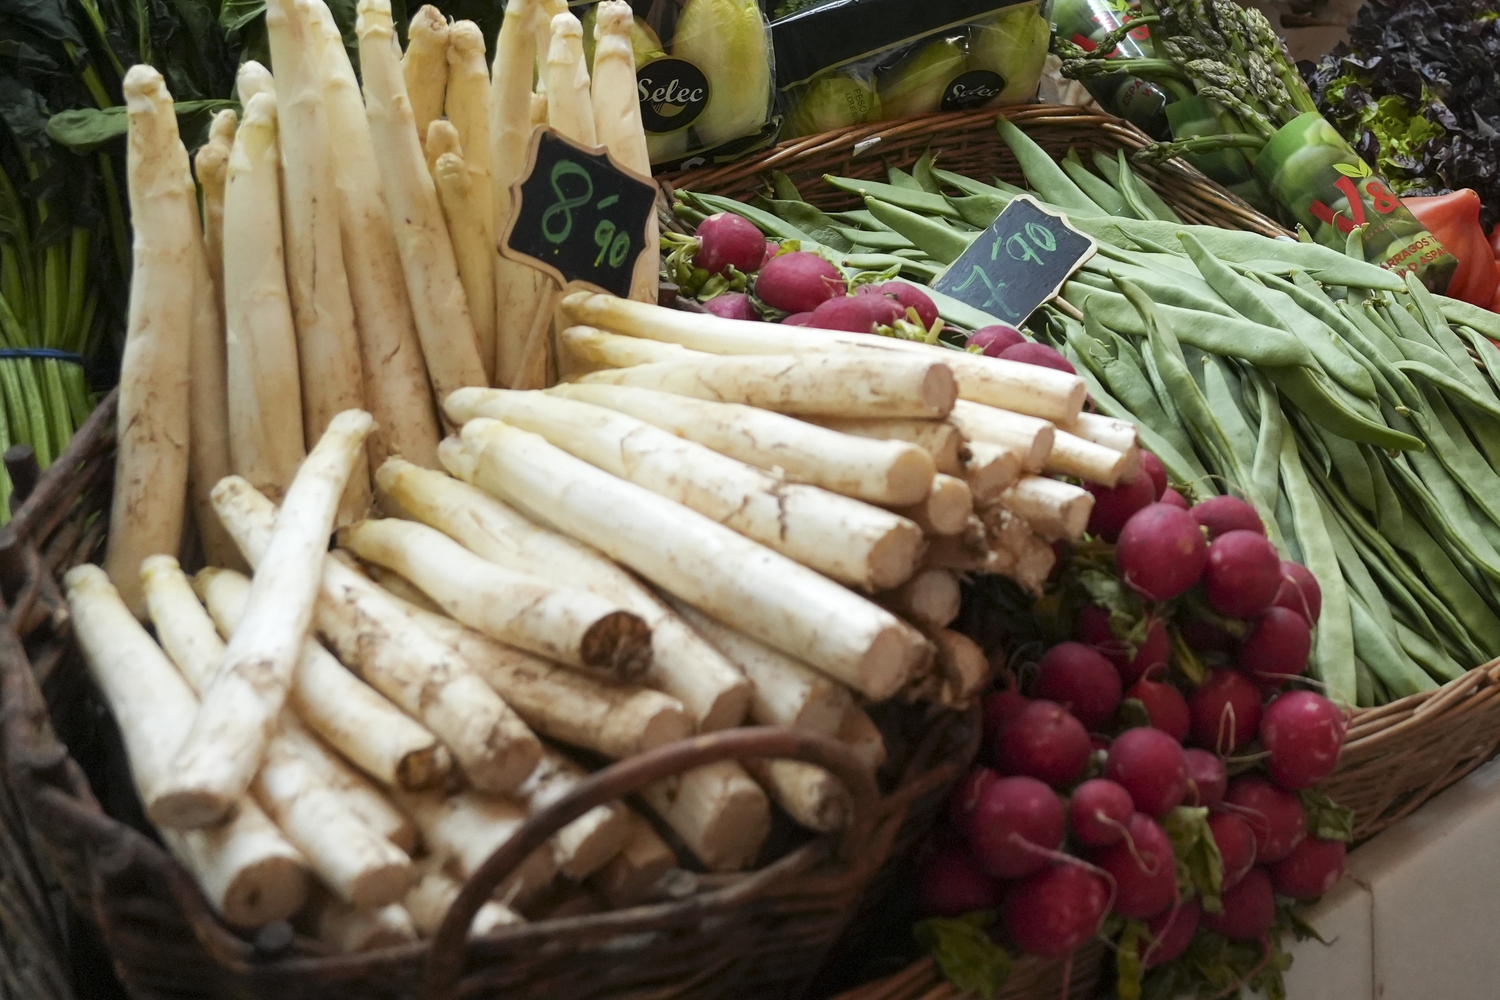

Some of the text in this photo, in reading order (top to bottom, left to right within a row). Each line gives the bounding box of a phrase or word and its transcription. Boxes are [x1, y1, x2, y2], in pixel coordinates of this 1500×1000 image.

[637, 78, 703, 103] Selec
[854, 88, 867, 113] PESO
[946, 84, 999, 101] Selec
